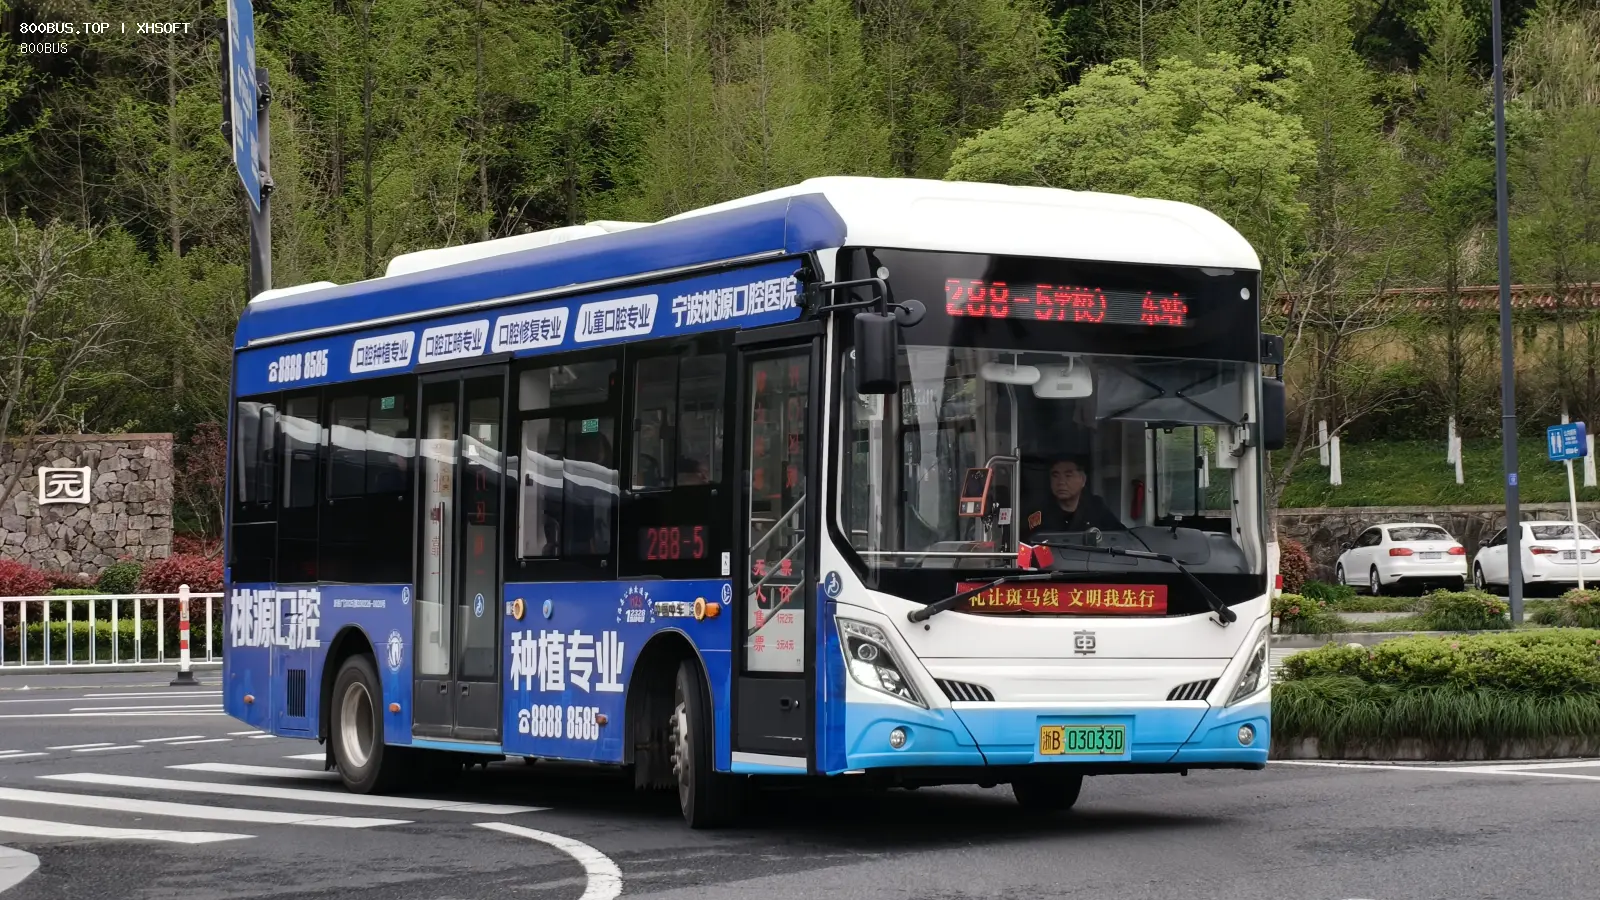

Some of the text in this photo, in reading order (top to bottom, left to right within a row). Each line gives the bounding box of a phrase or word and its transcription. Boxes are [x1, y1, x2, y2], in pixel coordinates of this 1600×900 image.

[671, 275, 797, 328] 宁波桃源口腔医院
[498, 316, 562, 346] 口腔修复专业
[582, 303, 650, 335] 儿童口腔专业
[356, 338, 409, 369] 口腔种植专业
[425, 328, 483, 358] 口腔正畸专业
[278, 349, 329, 383] 8888 8585
[38, 466, 91, 505] 园
[647, 526, 704, 560] 288-5
[968, 588, 1155, 608] 礼让斑马线 文明我先行
[230, 588, 321, 650] 桃源口腔
[510, 629, 625, 693] 种植专业
[531, 704, 599, 740] 8888 8585
